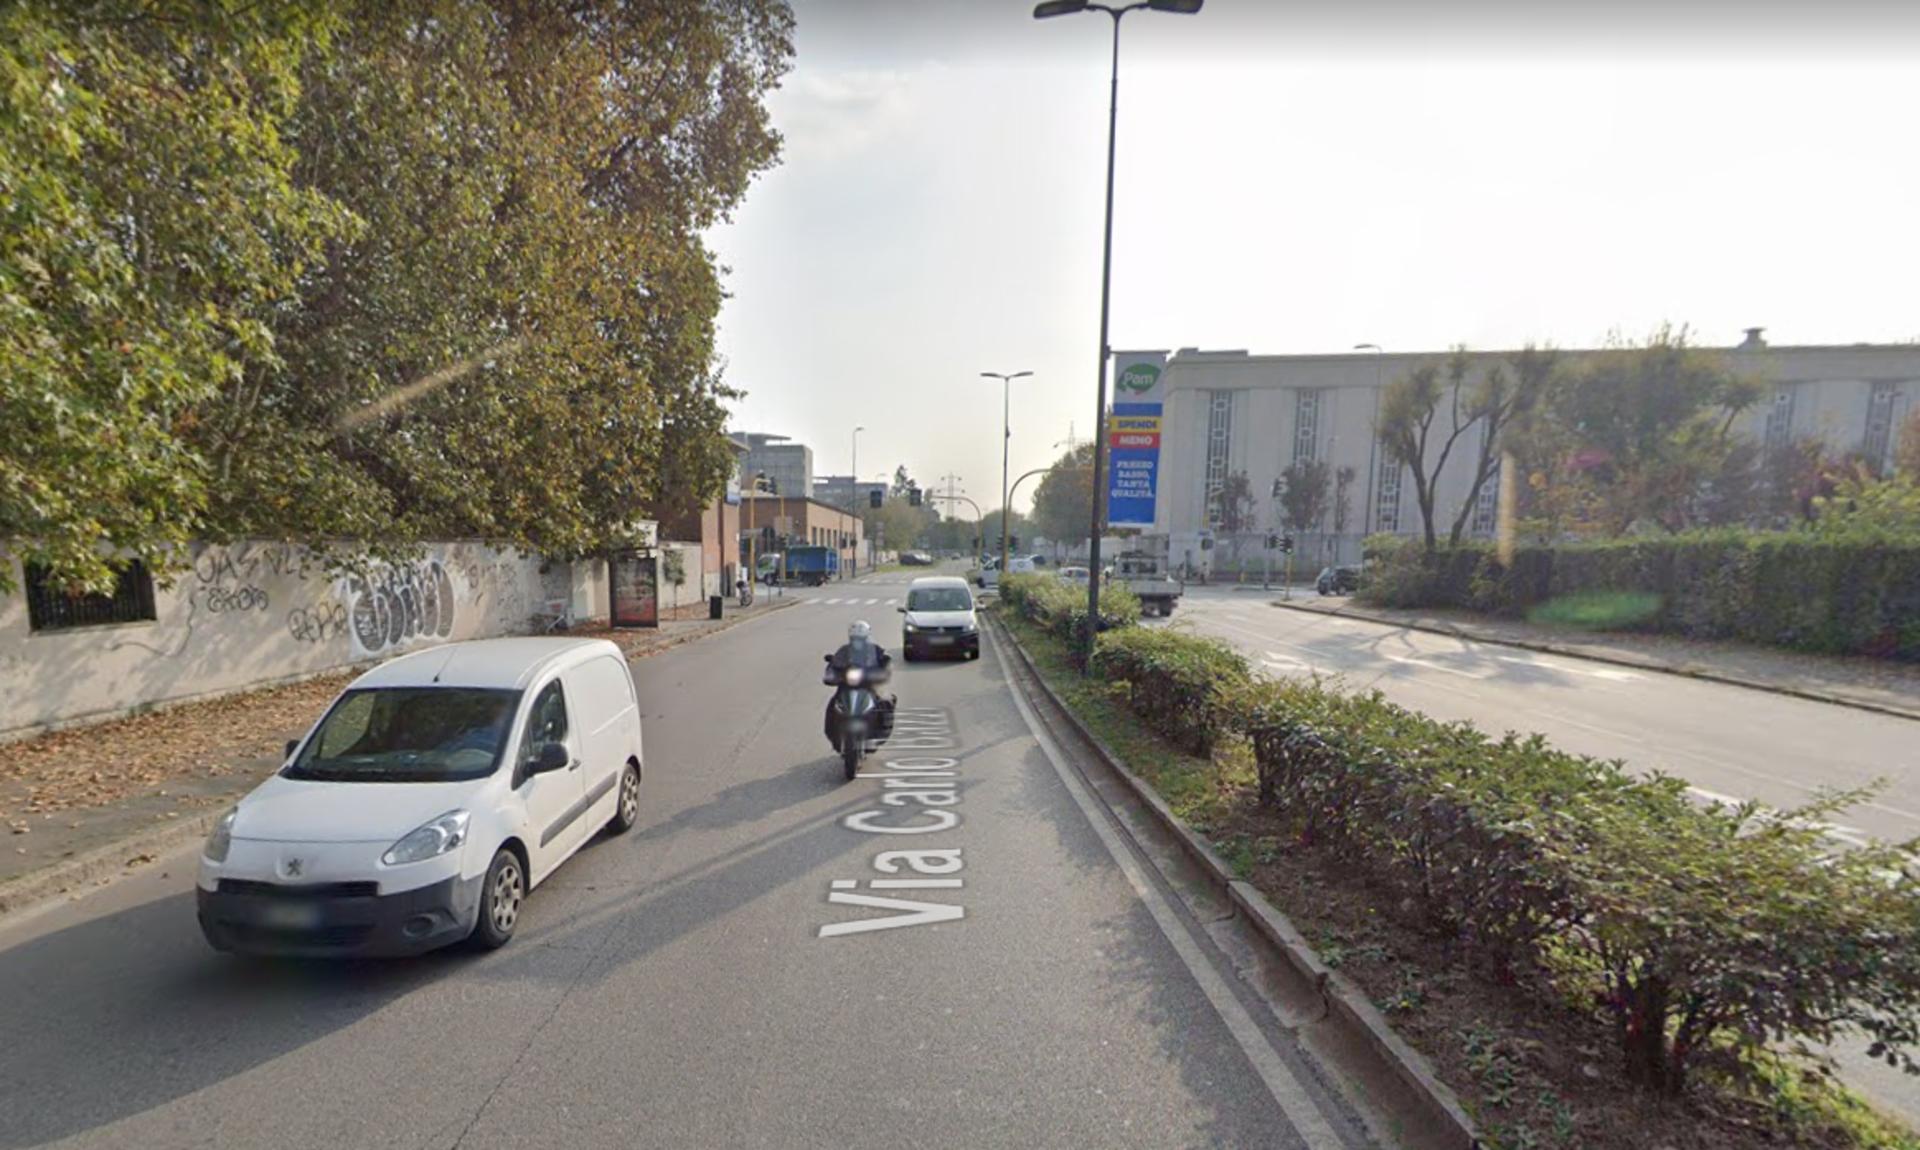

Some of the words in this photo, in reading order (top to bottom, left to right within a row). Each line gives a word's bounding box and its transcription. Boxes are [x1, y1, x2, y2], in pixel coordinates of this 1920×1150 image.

[1123, 371, 1154, 386] Pam
[1118, 434, 1154, 447] MENO
[1116, 460, 1154, 469] PREZZO
[1117, 479, 1151, 488] TANTA
